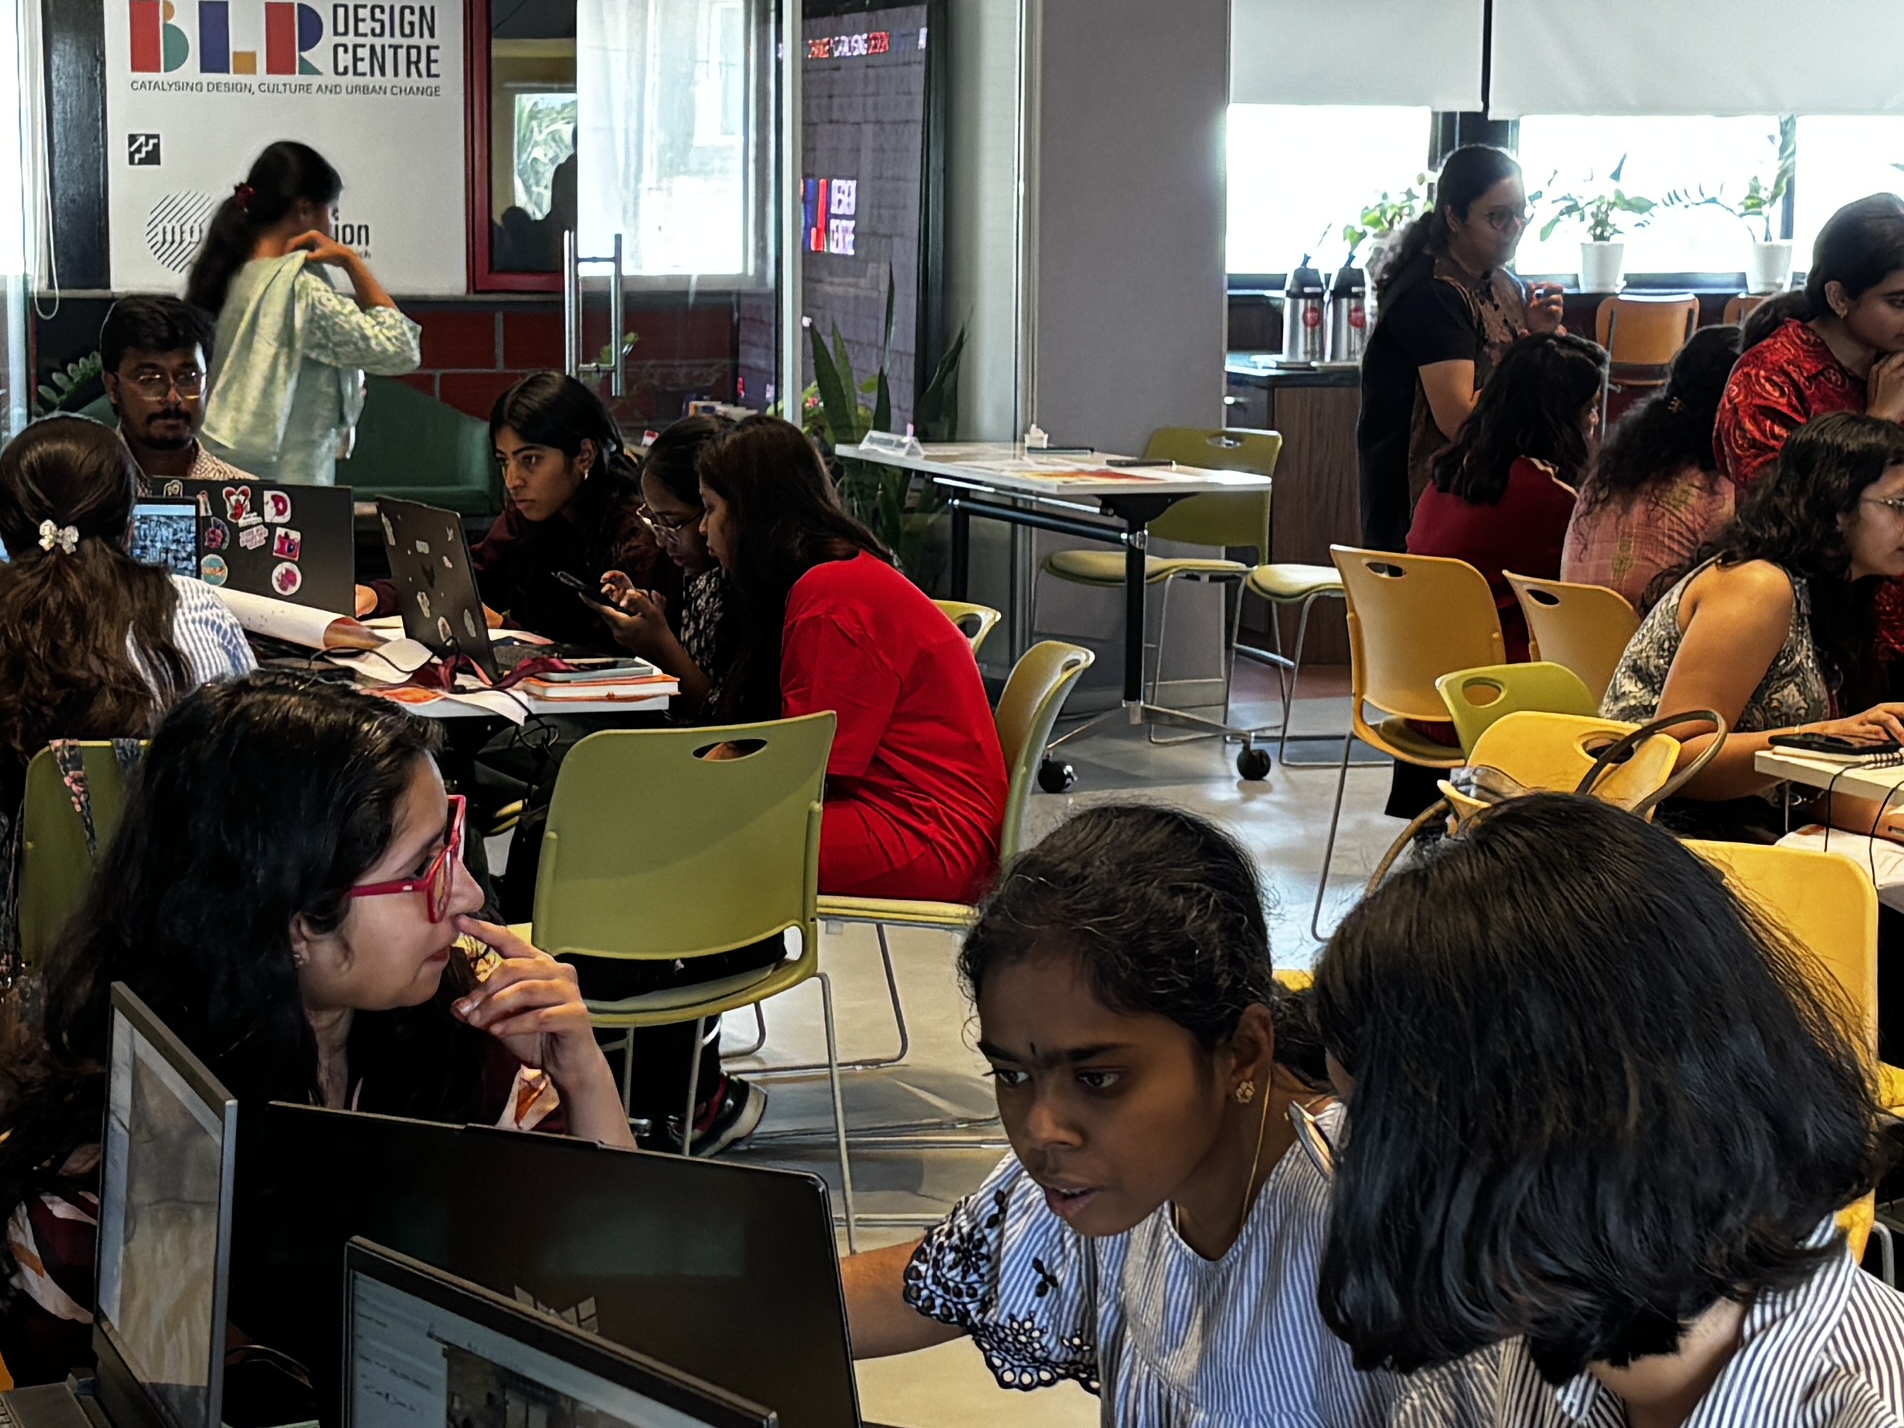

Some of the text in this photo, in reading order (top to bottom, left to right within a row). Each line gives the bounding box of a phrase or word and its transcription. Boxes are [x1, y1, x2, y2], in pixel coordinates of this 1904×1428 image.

[332, 2, 437, 40] DESIGN
[332, 42, 442, 80] CENTRE
[130, 80, 441, 97] CATALYSING DESIGN, CULTURE AND URBAN CHANGE
